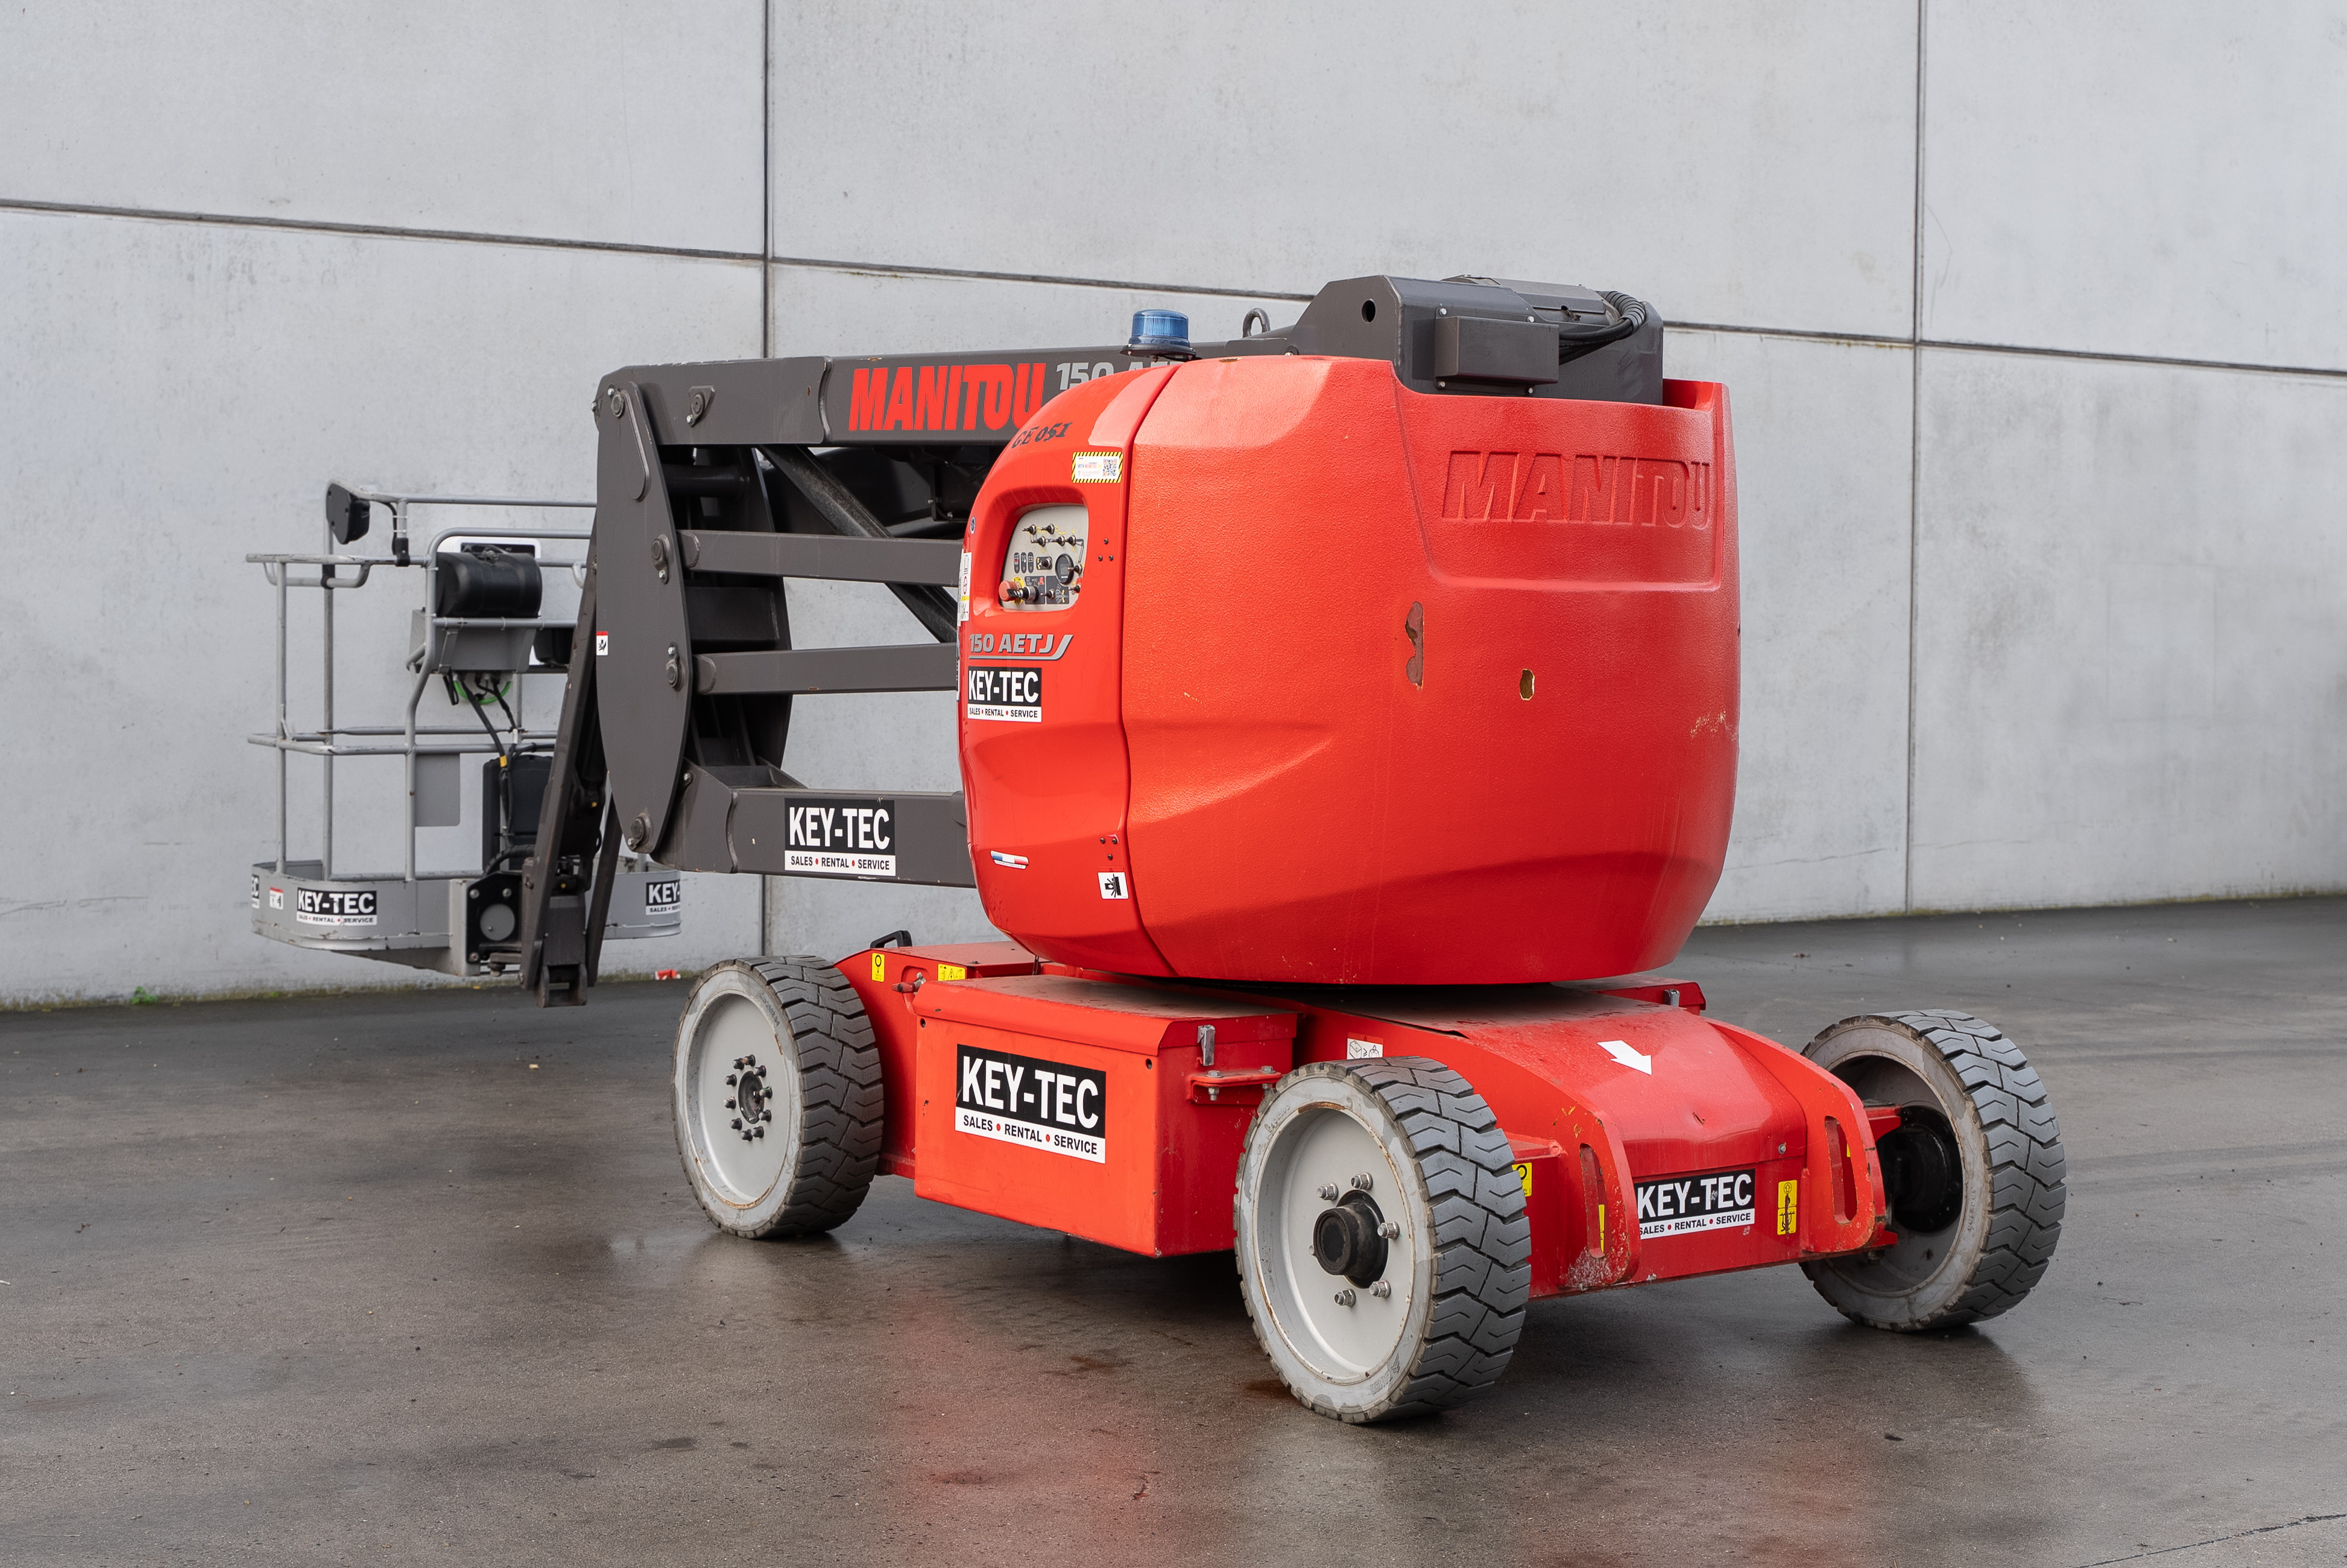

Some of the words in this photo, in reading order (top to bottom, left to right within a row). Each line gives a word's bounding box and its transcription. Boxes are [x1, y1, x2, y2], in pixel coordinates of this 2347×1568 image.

[848, 363, 1046, 431] MANITOU
[1035, 422, 1073, 442] 051
[1442, 450, 1710, 530] MANITOU
[969, 633, 994, 653] 150
[998, 633, 1054, 654] AETJ
[968, 669, 1039, 703] KEY-TEC
[985, 708, 1004, 716] RENTAL
[789, 806, 890, 850] KEY-TEC
[791, 856, 813, 866] SALES
[821, 857, 849, 868] RENTAL
[858, 859, 889, 870] SERVICE
[297, 889, 374, 914] KEY-TEC
[962, 1055, 1099, 1129] KEY-TEC
[963, 1115, 993, 1131] SALES
[1004, 1124, 1042, 1142] RENTAL
[1054, 1134, 1098, 1155] SERVICE
[1637, 1174, 1752, 1219] KEY-TEC
[1675, 1219, 1707, 1231] RENTAL
[1716, 1212, 1751, 1225] SERVICE
